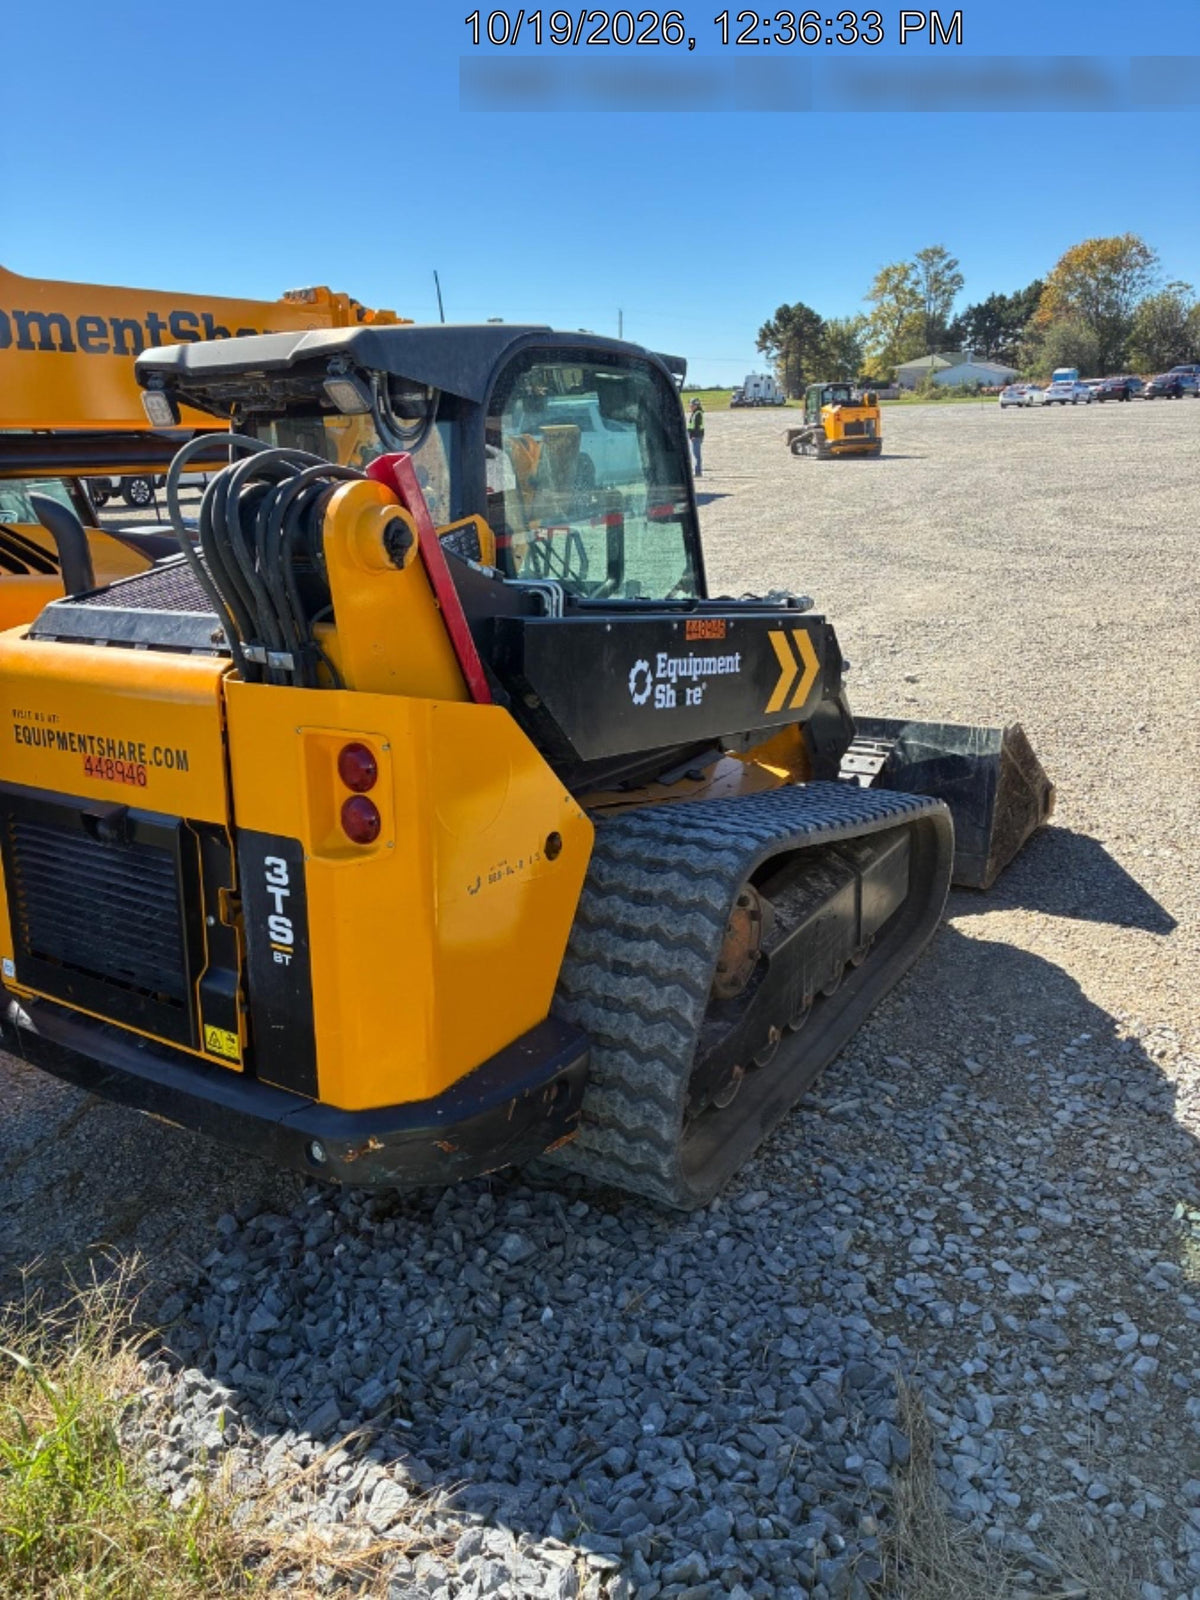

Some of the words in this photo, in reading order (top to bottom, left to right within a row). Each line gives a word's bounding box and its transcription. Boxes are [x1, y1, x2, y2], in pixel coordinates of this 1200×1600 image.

[655, 651, 742, 683] Equipment
[14, 724, 189, 772] EQUIPMENTSHARE.COM
[84, 755, 148, 787] 448946
[264, 856, 294, 945] 3TS
[273, 950, 292, 966] BT
